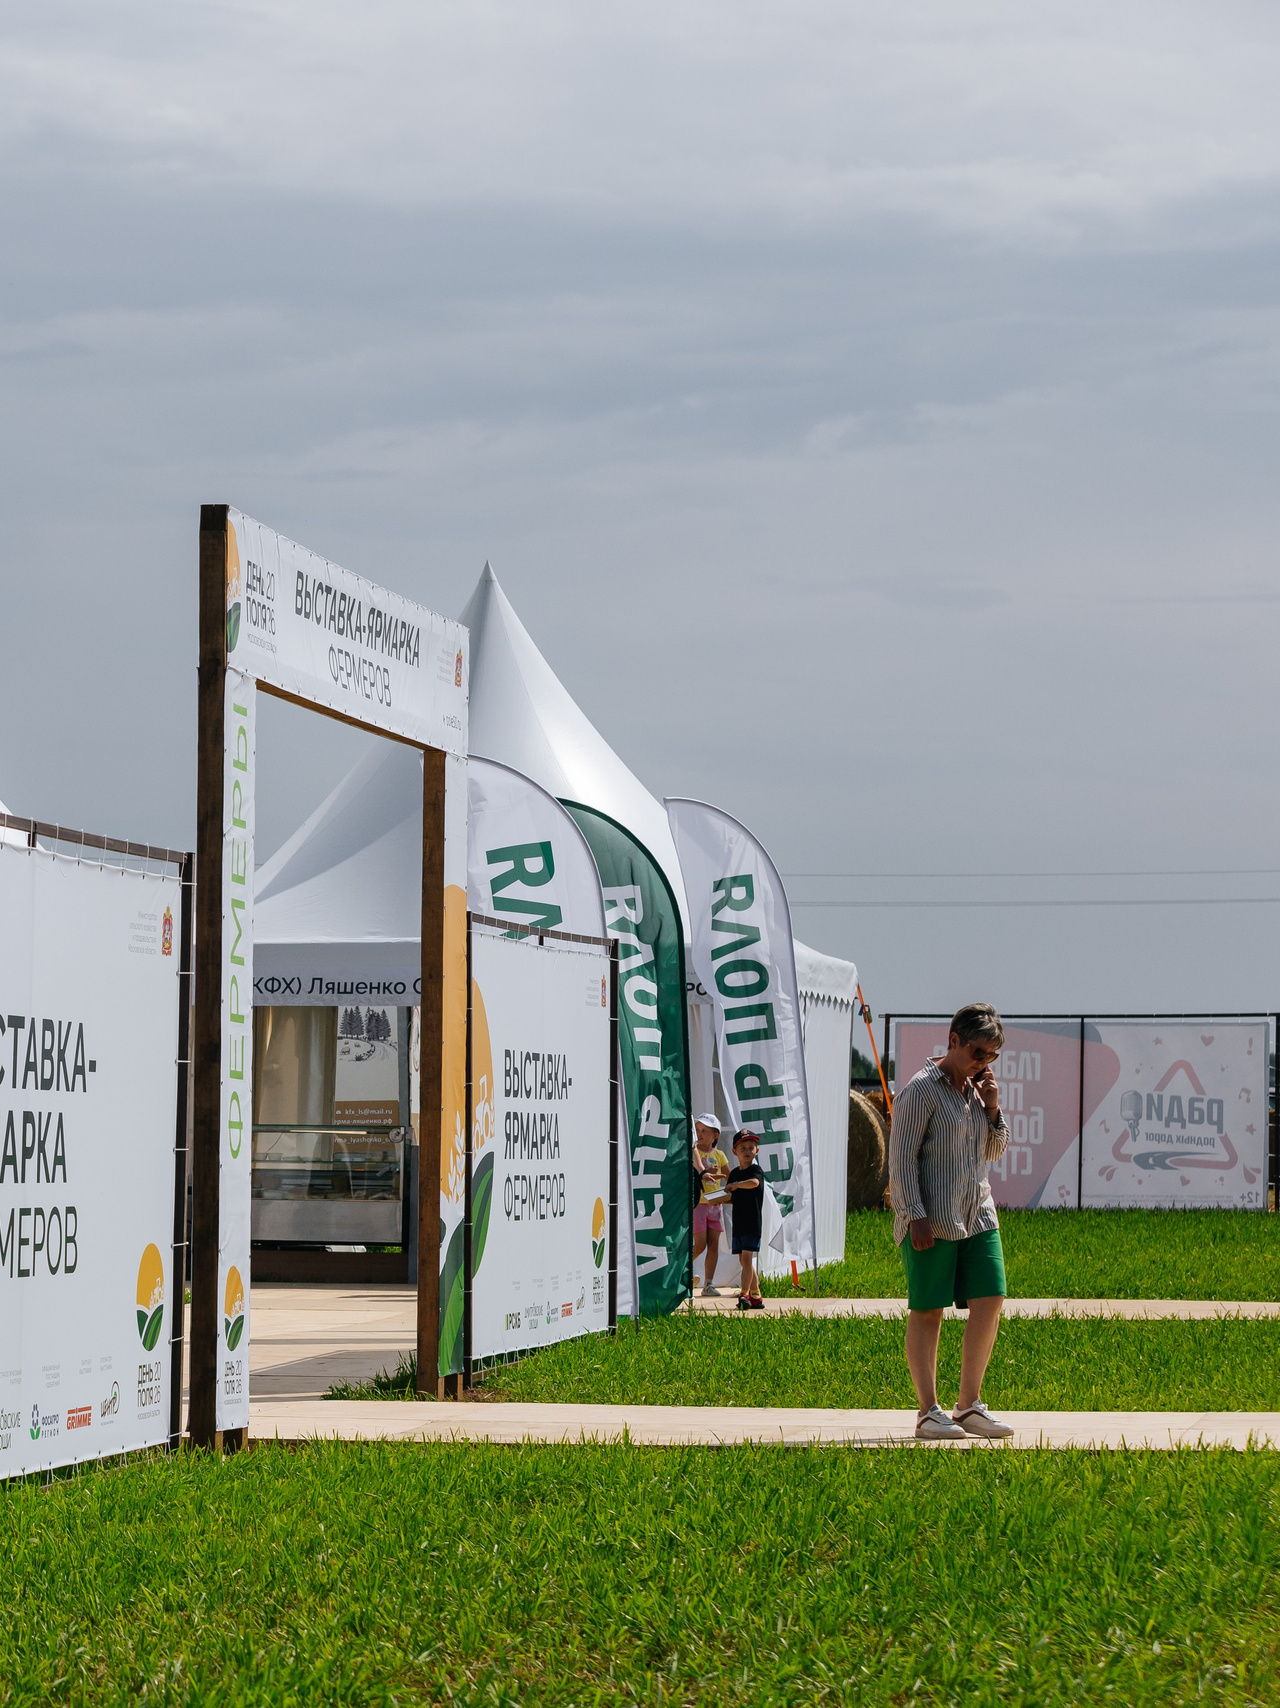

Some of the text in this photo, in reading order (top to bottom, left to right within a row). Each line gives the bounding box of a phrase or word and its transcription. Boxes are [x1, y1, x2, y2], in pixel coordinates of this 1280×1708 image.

[266, 571, 276, 602] 20
[246, 595, 267, 631] ПОЛЯ
[294, 569, 421, 669] ВЫСТАВКА-ЯРМАРКА
[328, 643, 392, 708] ФЕРМЕРОВ
[227, 702, 250, 1161] ФЕРМЕРЫ
[307, 977, 407, 995] Ляшенко
[504, 1048, 573, 1101] ВЫСТАВКА-
[504, 1111, 561, 1160] ЯРМАРКА
[503, 1172, 566, 1222] ФЕРМЕРОВ
[137, 1362, 154, 1388] ДЕНЬ
[154, 1361, 162, 1381] 20
[235, 1359, 243, 1376] 20
[137, 1385, 161, 1408] ПОЛЯ 26
[235, 1378, 243, 1394] 26
[41, 1427, 60, 1439] РЕГИОН
[66, 1412, 92, 1431] GRIMME
